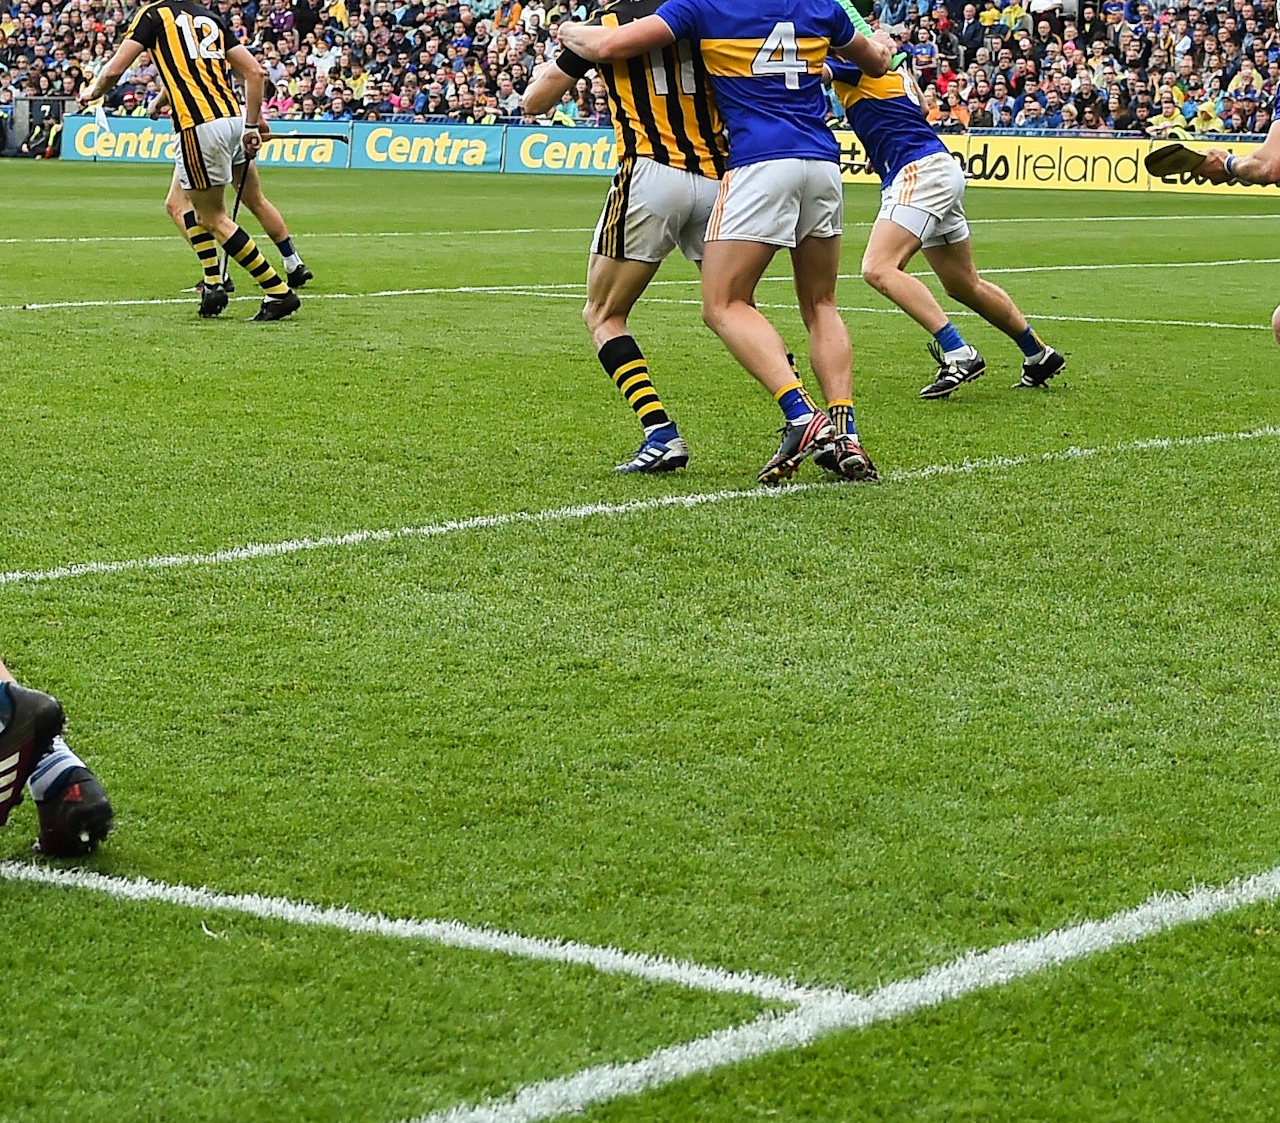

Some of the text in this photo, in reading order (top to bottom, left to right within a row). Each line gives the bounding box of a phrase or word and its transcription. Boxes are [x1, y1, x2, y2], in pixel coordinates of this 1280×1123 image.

[175, 11, 225, 60] 12
[751, 21, 807, 90] 4
[366, 127, 488, 166] Centra
